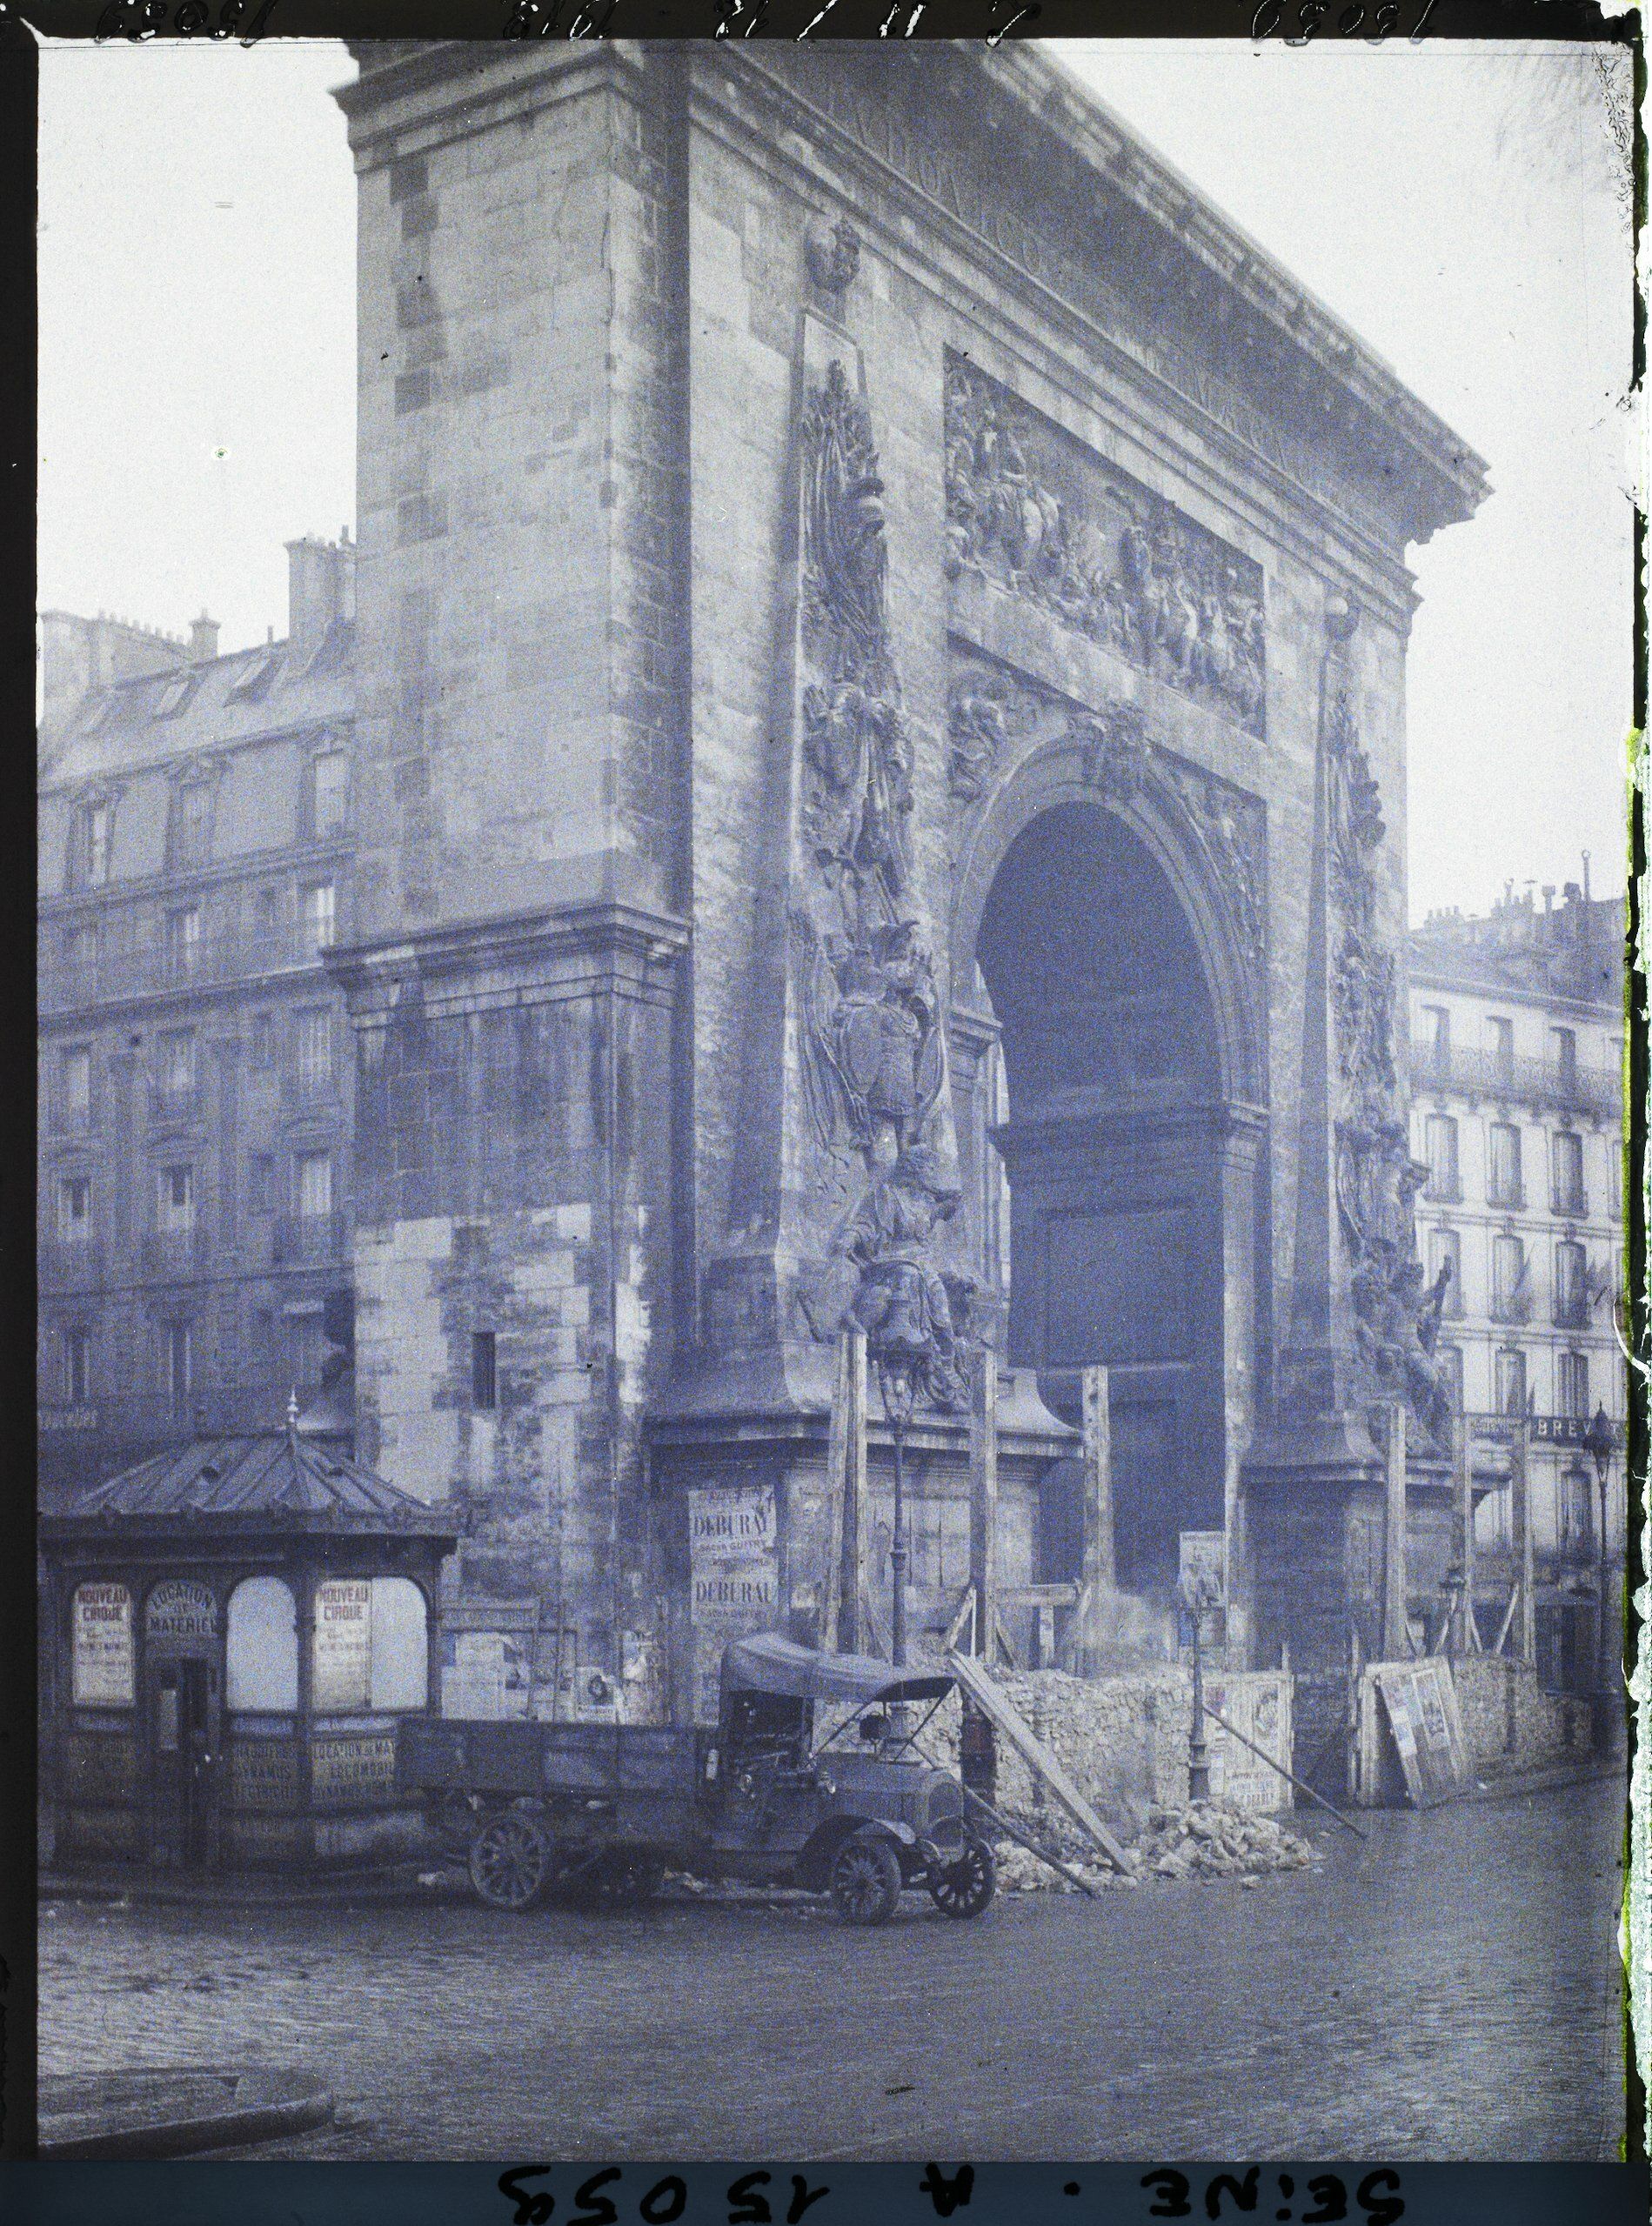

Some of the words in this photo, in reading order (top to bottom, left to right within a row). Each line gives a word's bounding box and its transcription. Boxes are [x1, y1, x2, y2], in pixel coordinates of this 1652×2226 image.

[78, 1588, 128, 1604] NOUVEAU
[151, 1582, 212, 1610] LOCATION
[318, 1588, 369, 1603] NOUVEAU
[83, 1607, 124, 1621] CIRQUE
[324, 1606, 364, 1621] CIRQUE
[919, 2162, 975, 2217] A
